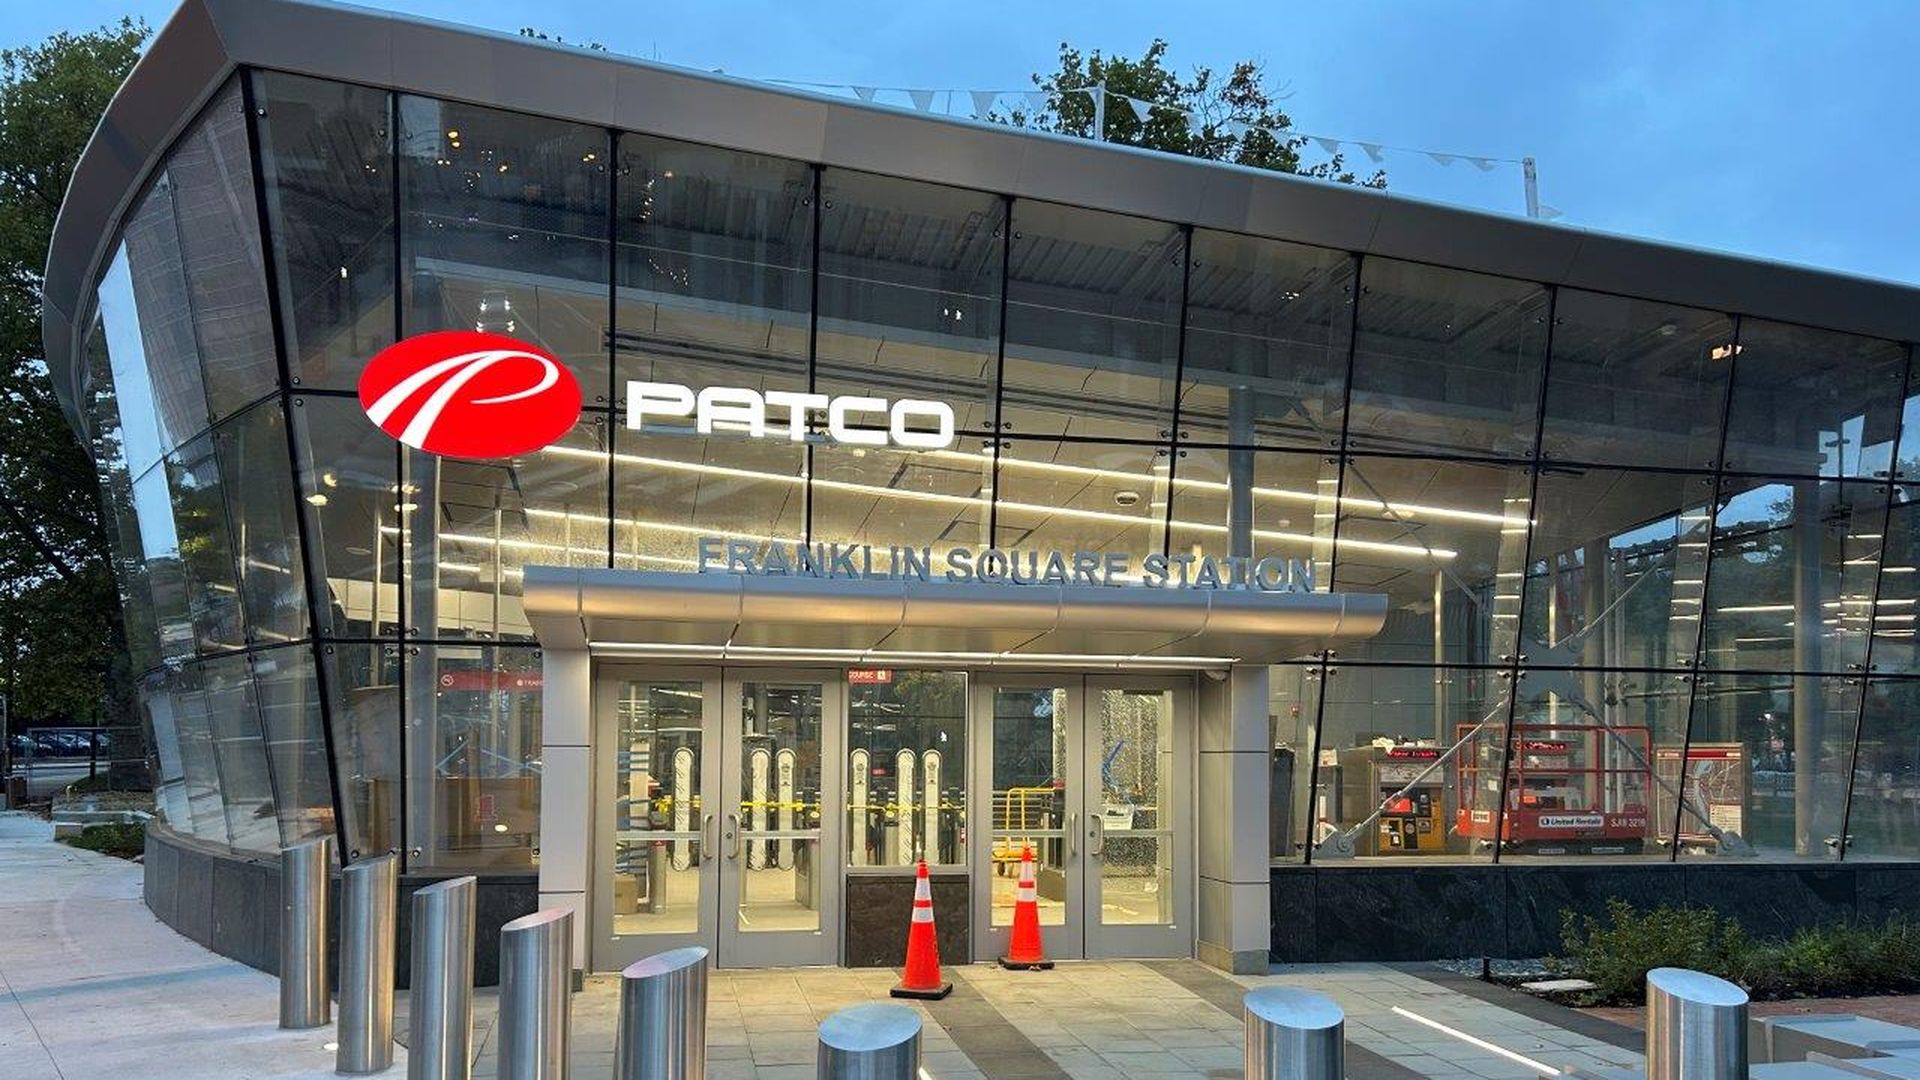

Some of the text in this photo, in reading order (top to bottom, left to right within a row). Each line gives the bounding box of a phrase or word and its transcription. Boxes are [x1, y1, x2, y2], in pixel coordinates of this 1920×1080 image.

[625, 380, 955, 449] PATCO
[698, 536, 1316, 592] FRANKLIN SQUARE STATION
[1550, 817, 1601, 825] United Rentals
